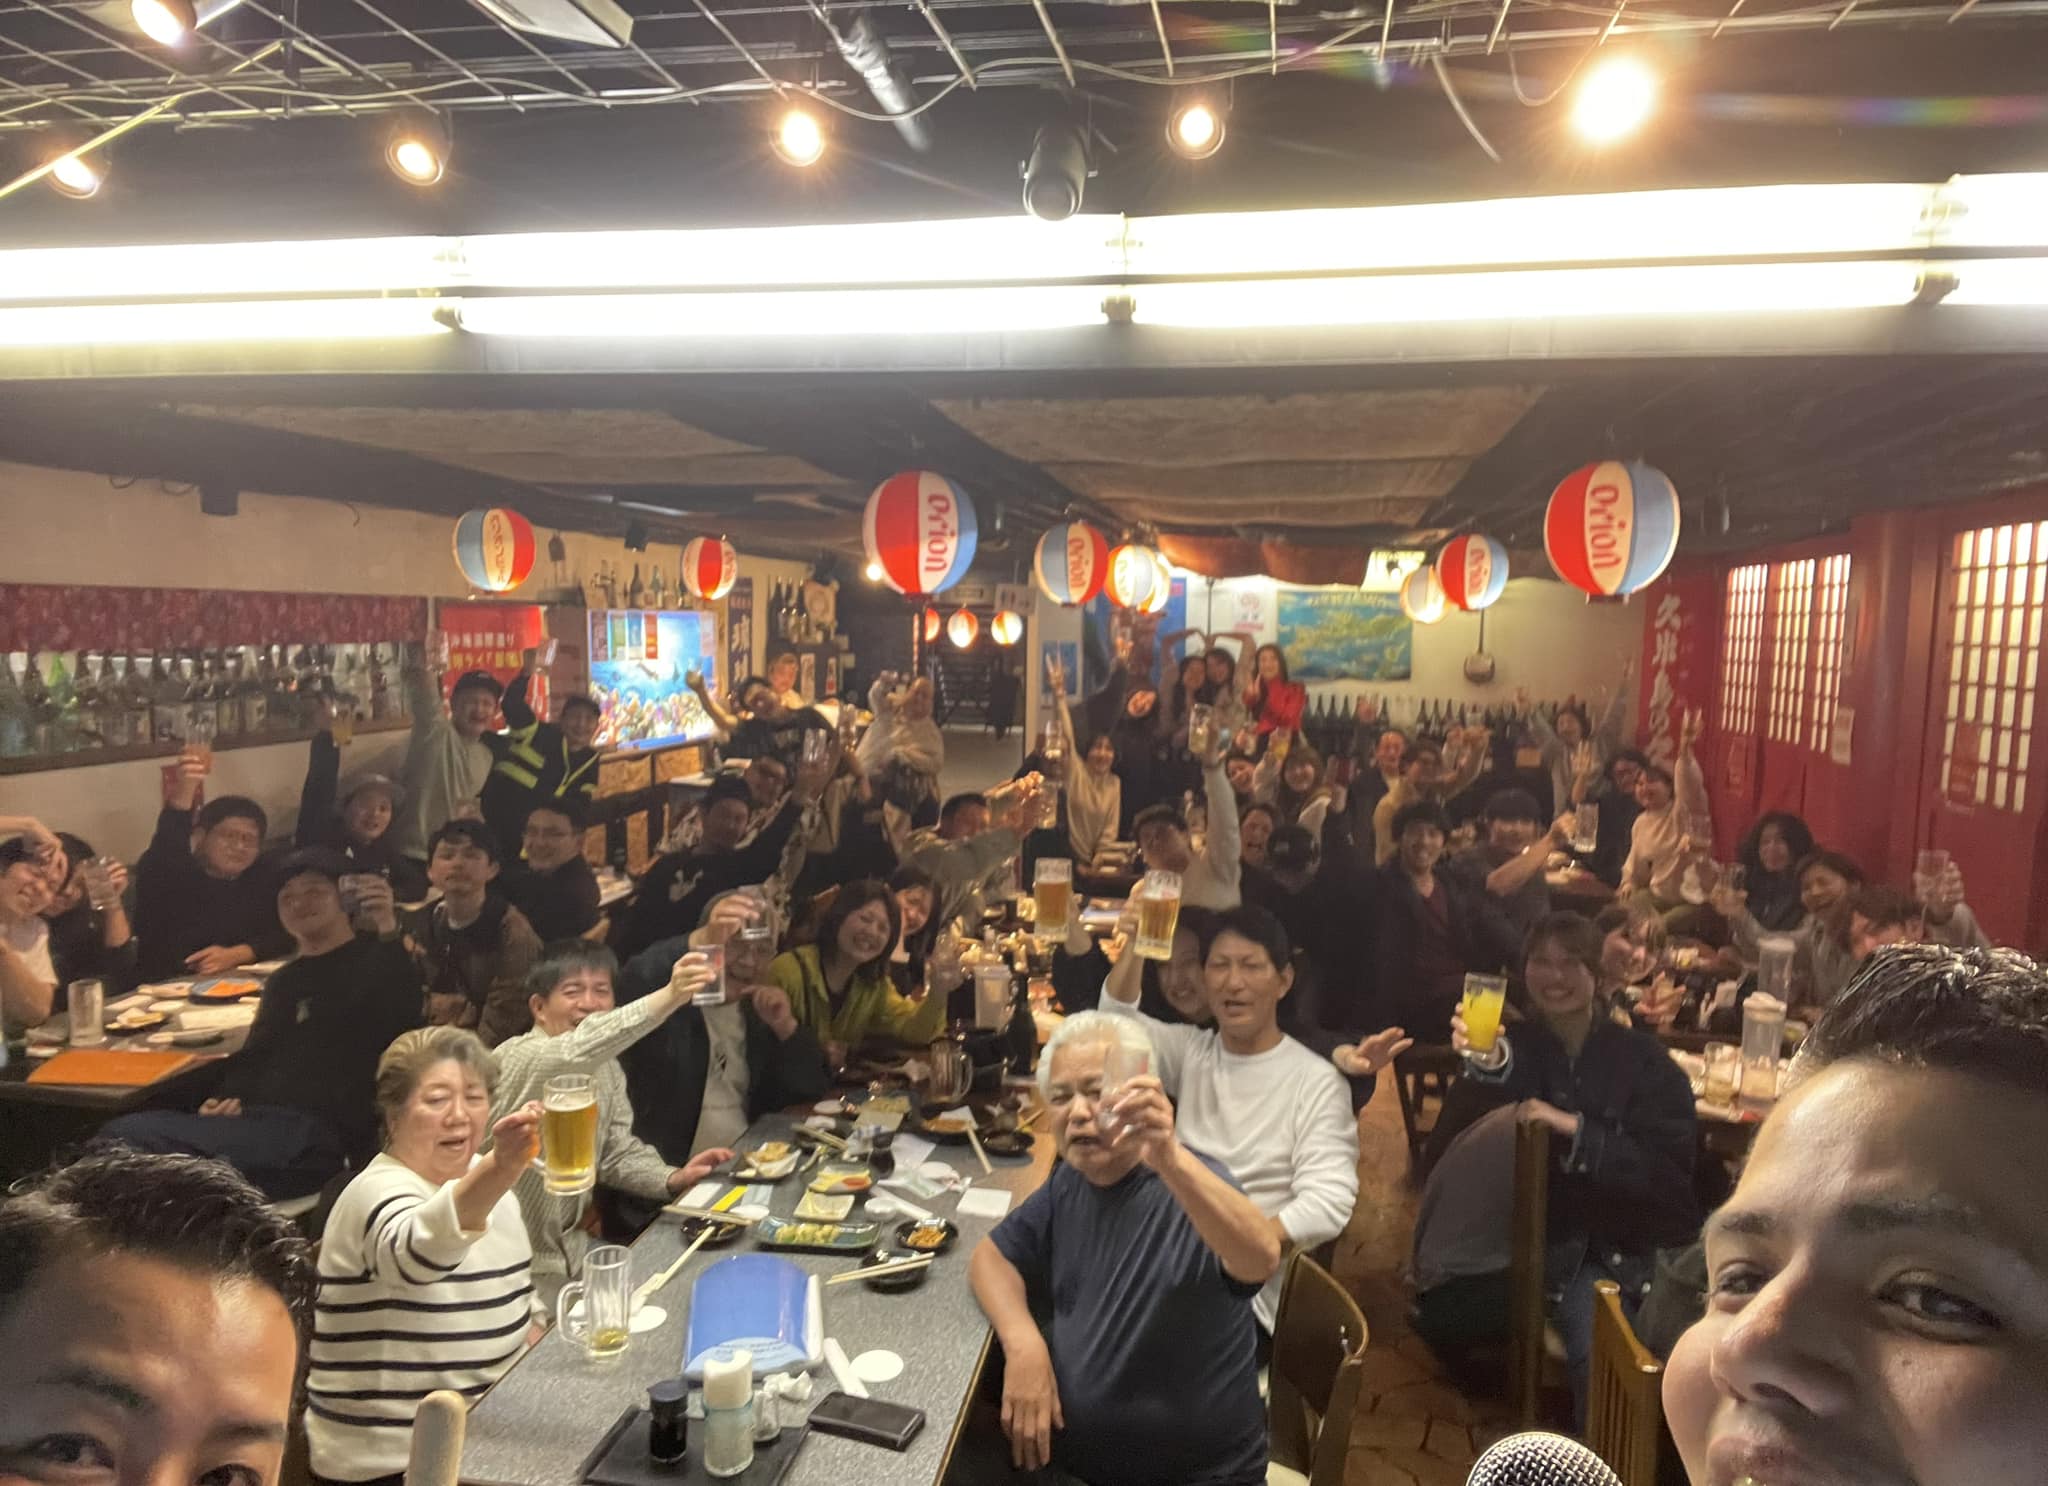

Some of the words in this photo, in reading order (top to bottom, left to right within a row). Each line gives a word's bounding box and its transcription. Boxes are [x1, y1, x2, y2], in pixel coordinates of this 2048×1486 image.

[925, 493, 956, 572] Orion
[1068, 538, 1090, 588] Orion
[1590, 484, 1626, 569] Orion
